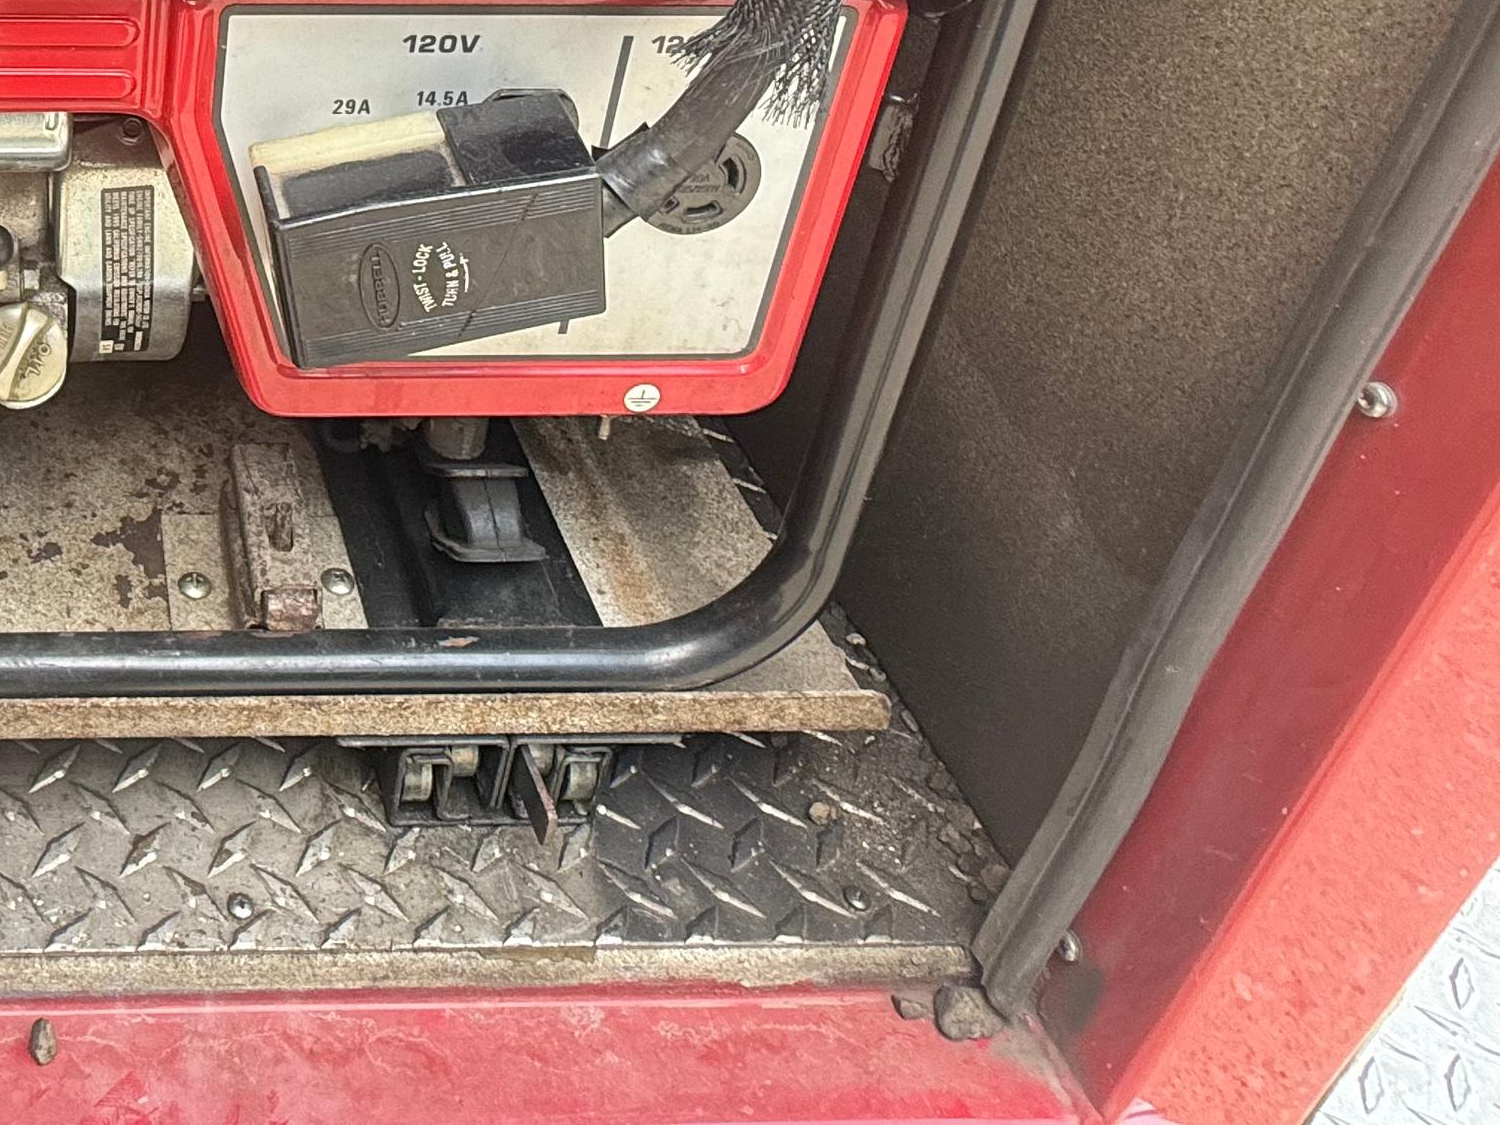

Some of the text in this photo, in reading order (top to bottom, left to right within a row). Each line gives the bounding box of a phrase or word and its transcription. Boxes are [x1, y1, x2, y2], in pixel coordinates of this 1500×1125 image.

[402, 34, 481, 54] 120V
[332, 98, 371, 116] 29A
[416, 90, 469, 107] 14.5A
[436, 241, 457, 270] PULL
